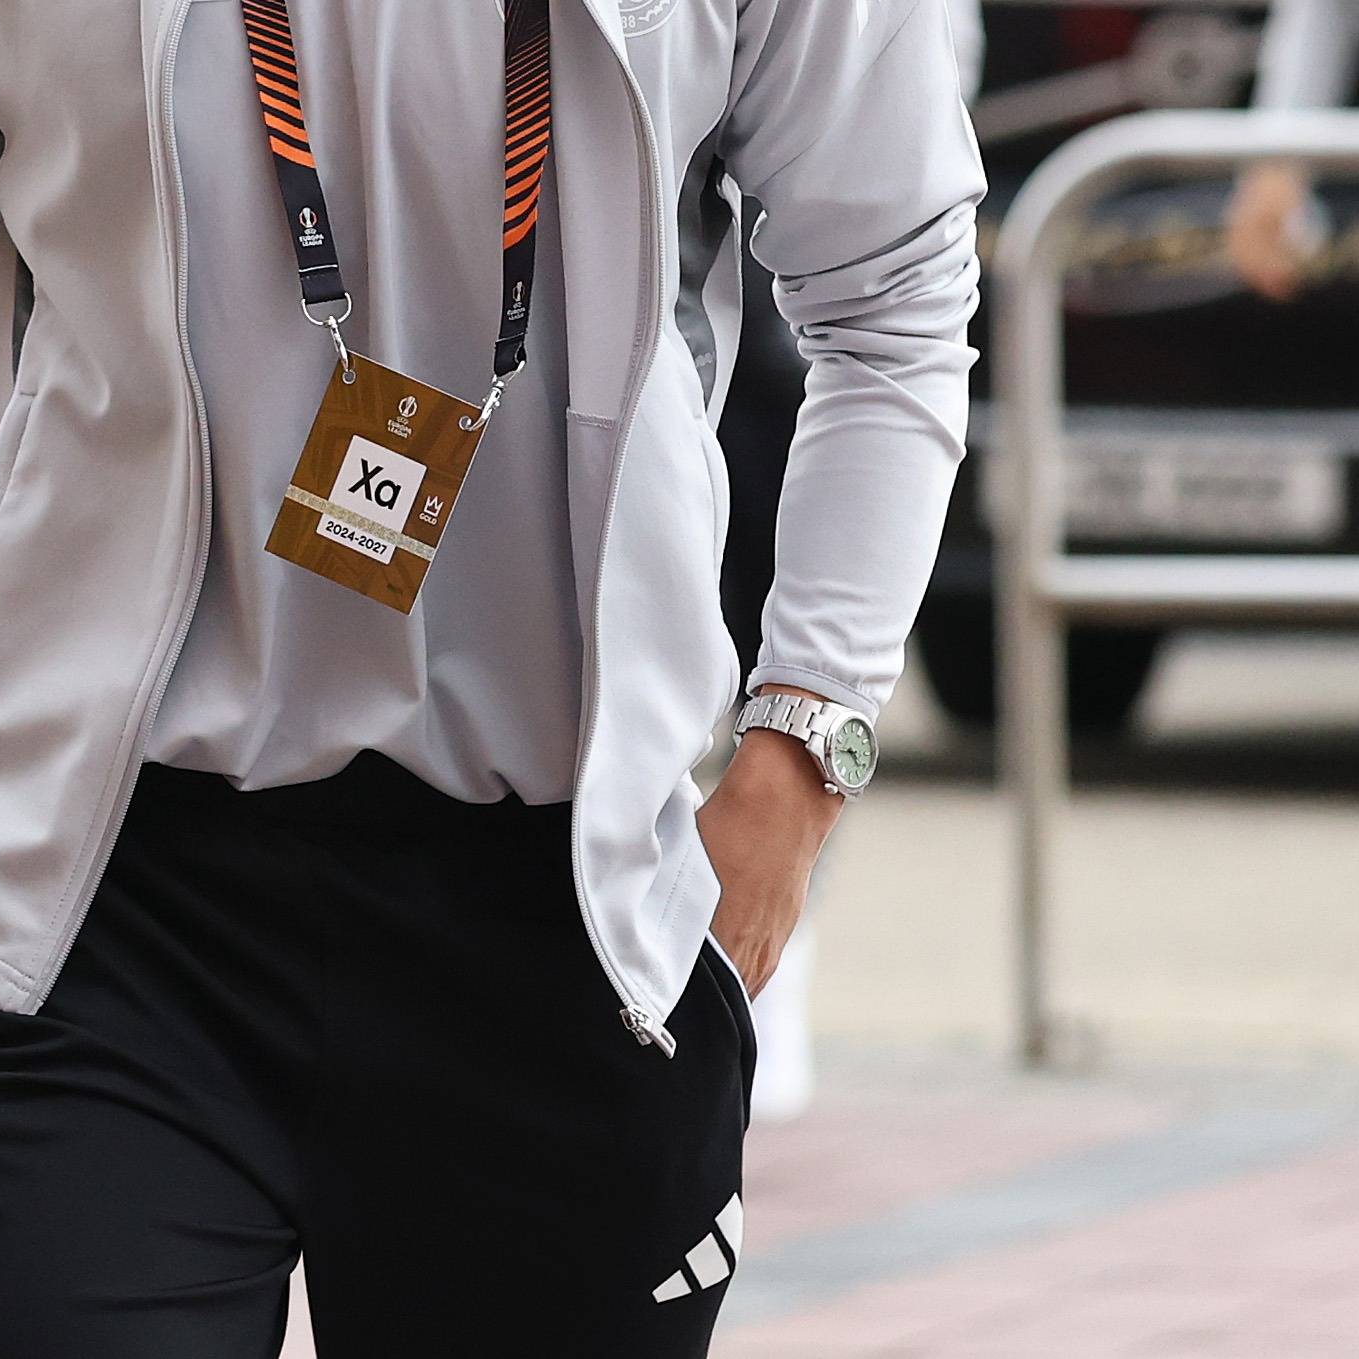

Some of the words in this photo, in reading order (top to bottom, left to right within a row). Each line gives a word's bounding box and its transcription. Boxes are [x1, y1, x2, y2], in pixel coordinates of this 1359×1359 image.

[348, 458, 401, 510] Xa
[419, 512, 438, 526] GOLD
[326, 521, 387, 555] 2024-2027
